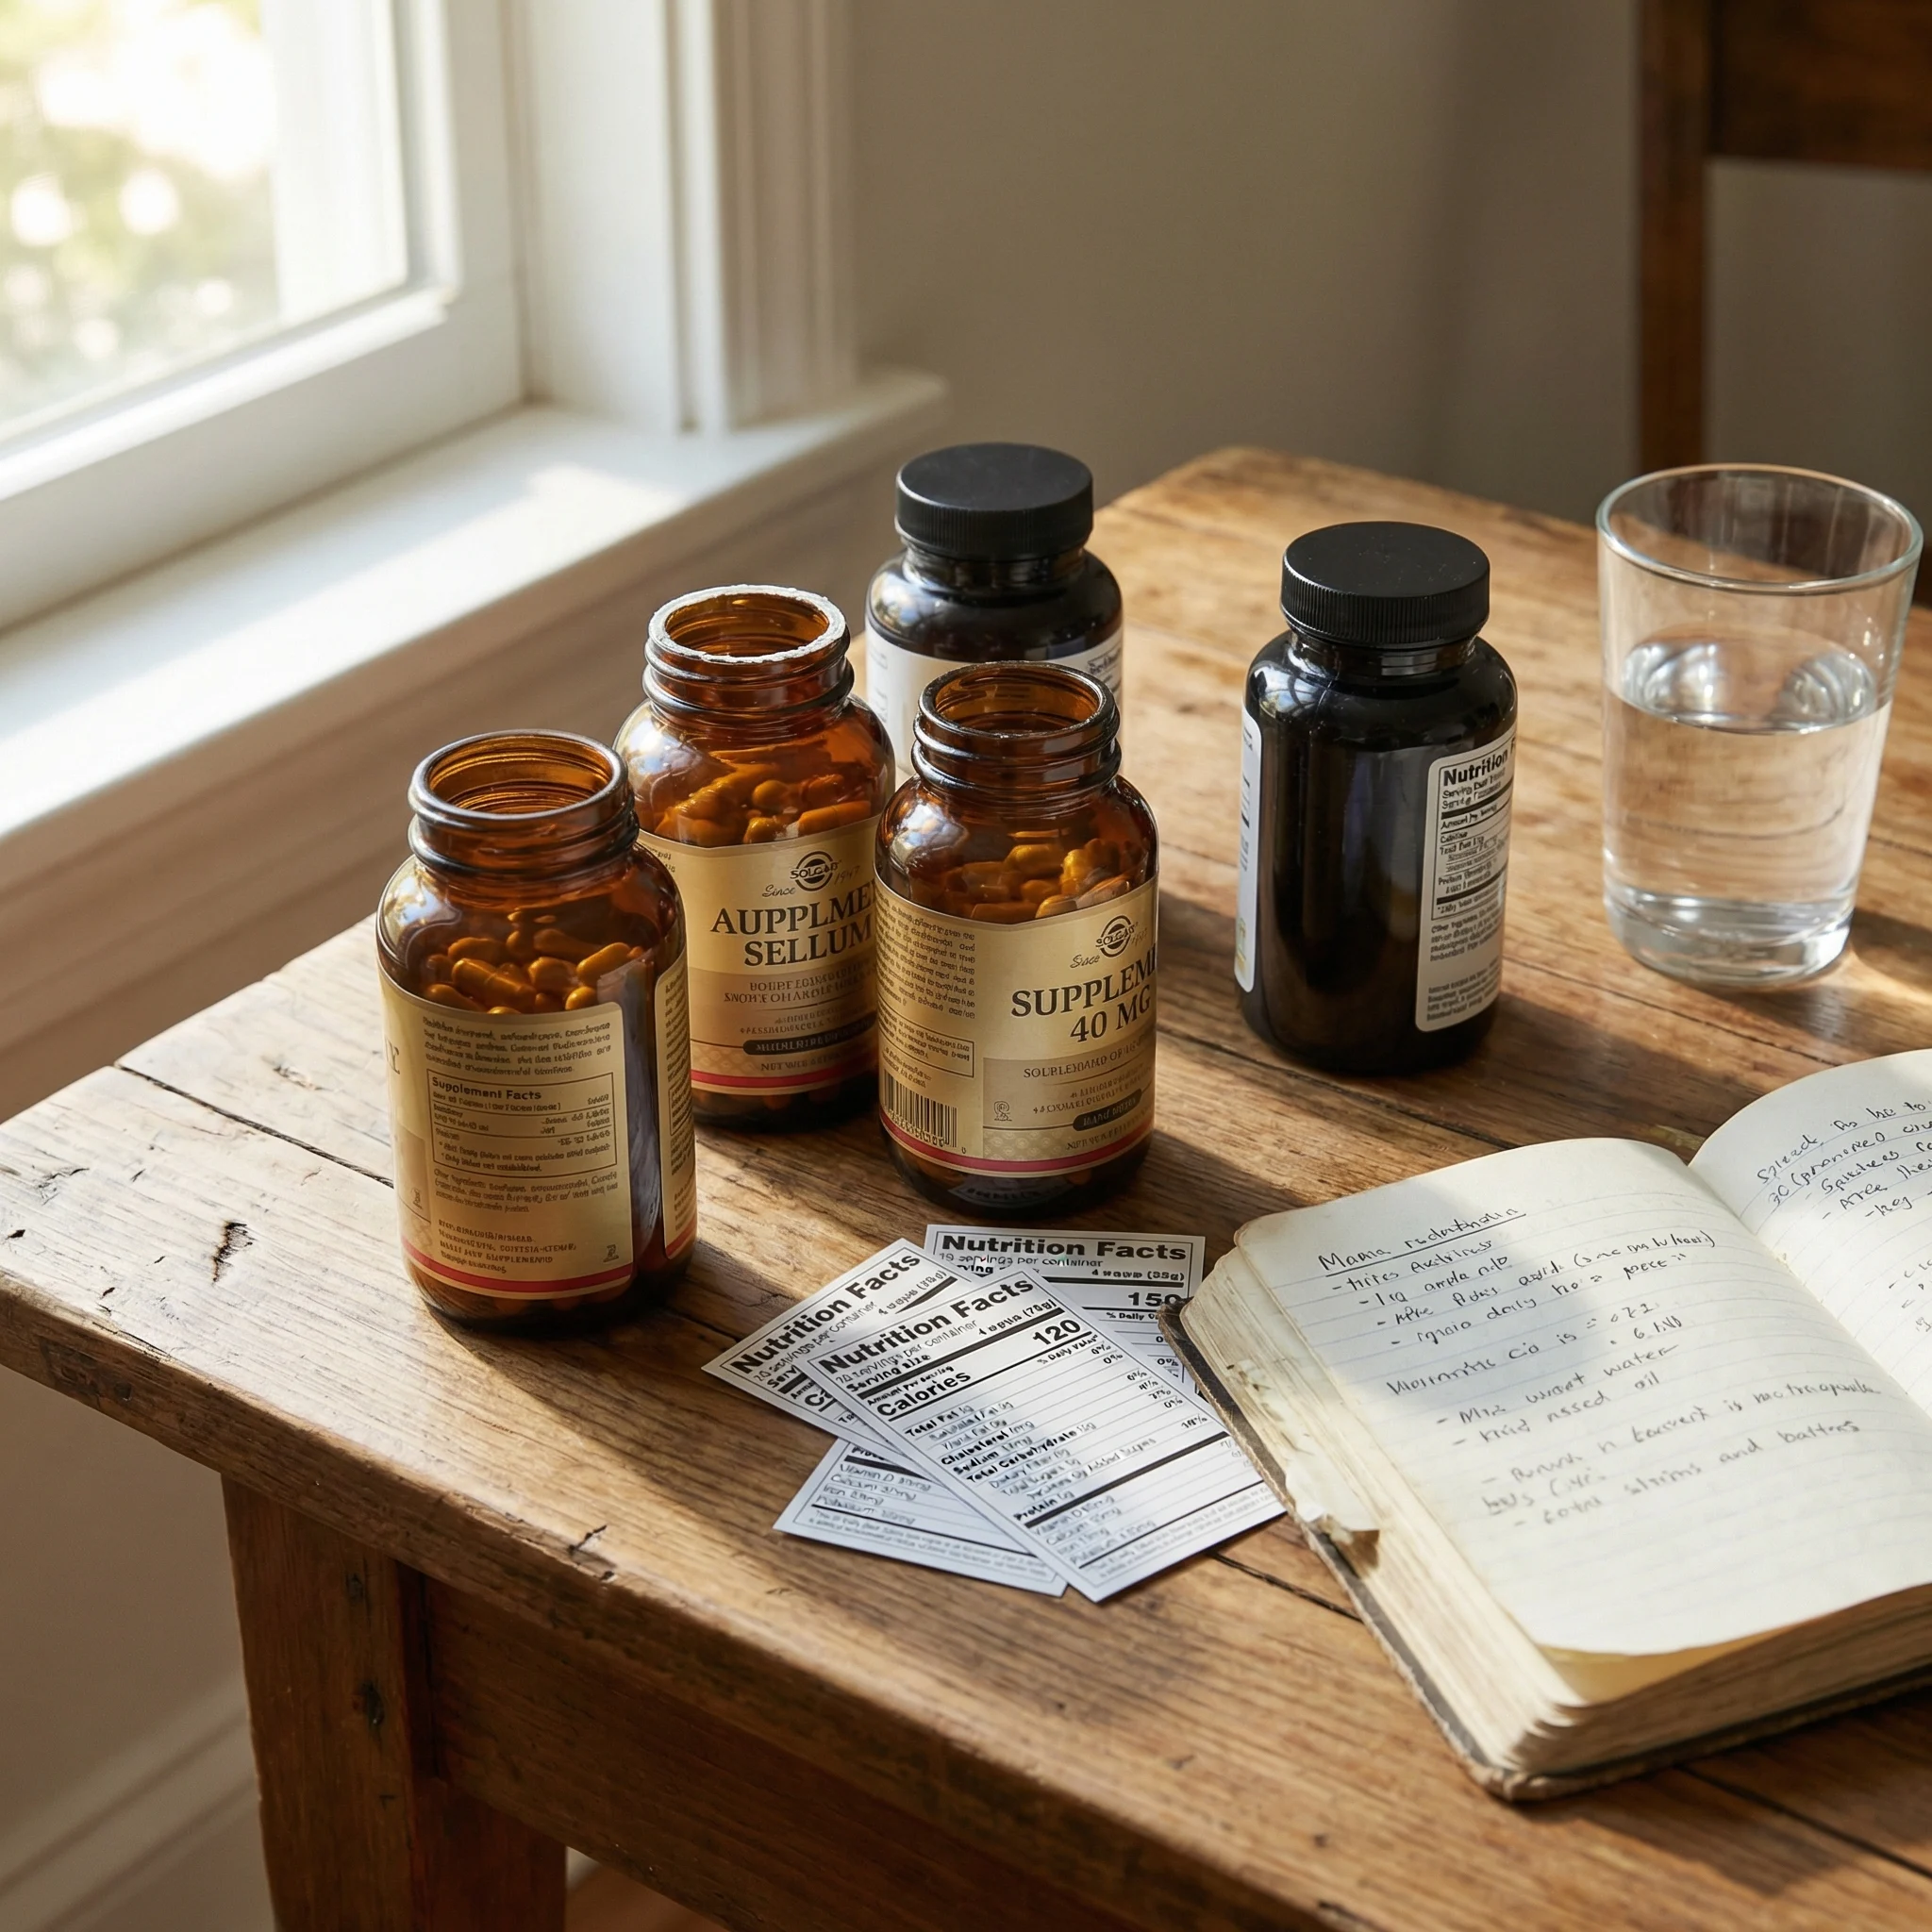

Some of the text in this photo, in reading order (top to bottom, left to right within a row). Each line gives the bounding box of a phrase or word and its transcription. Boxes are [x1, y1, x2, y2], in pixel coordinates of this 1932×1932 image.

[1443, 749, 1508, 786] Nutrition
[762, 884, 796, 897] Since
[743, 913, 873, 967] SELLUM
[1070, 984, 1151, 1043] 40 MG
[507, 1090, 541, 1100] Facts
[942, 1235, 1188, 1260] Nutrition Facts
[730, 1297, 852, 1374] Nutrition
[845, 1254, 921, 1300] Facts
[818, 1313, 952, 1374] Nutrition
[950, 1278, 1034, 1318] Facts
[876, 1371, 971, 1416] Calories
[1033, 1319, 1081, 1345] 120
[1603, 1344, 1679, 1378] water
[1719, 1439, 1764, 1465] and
